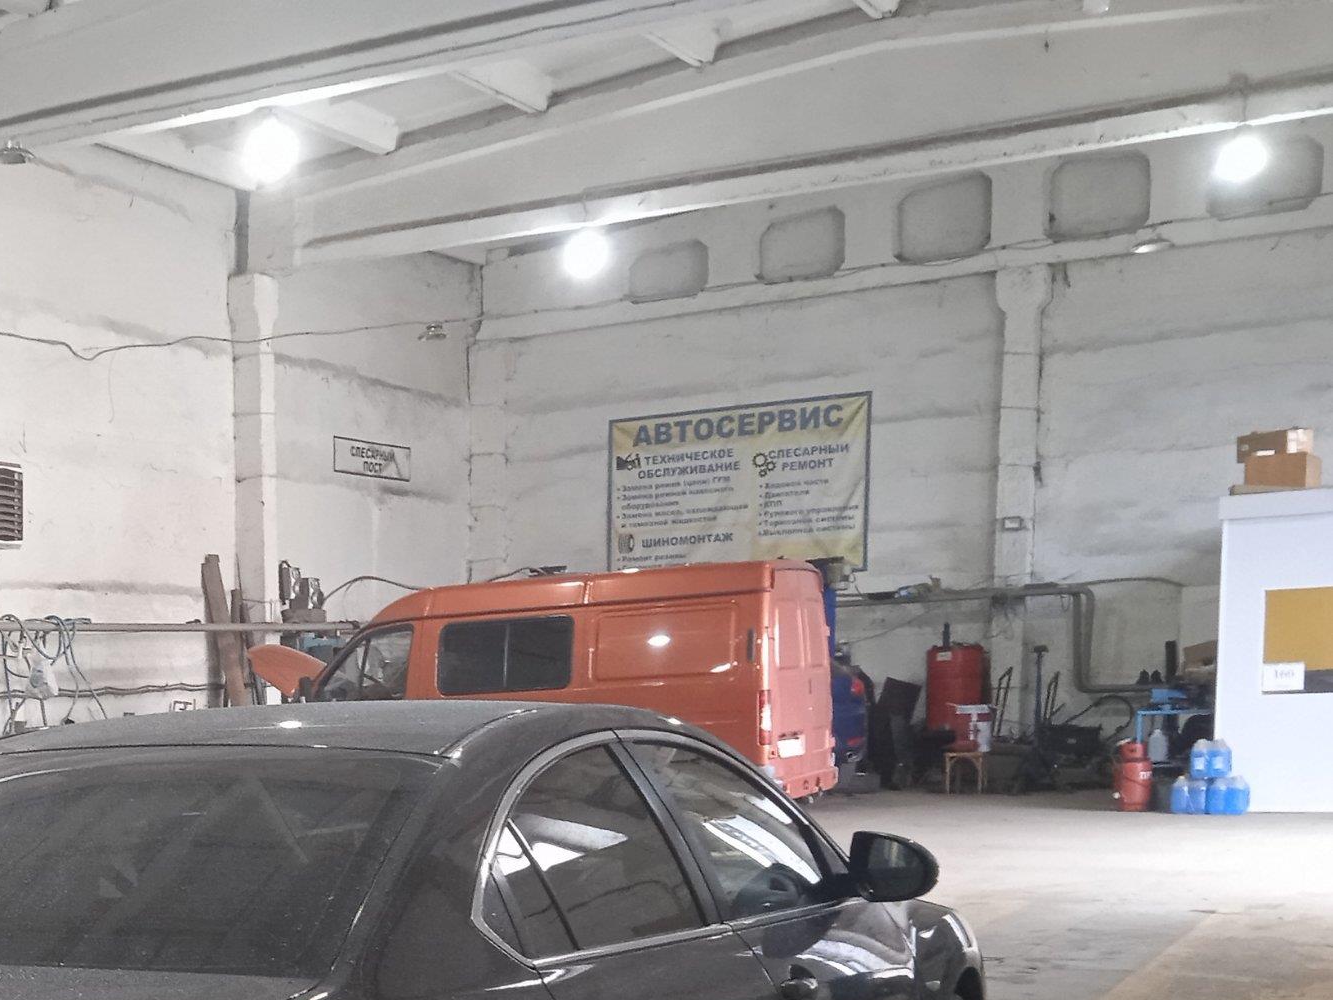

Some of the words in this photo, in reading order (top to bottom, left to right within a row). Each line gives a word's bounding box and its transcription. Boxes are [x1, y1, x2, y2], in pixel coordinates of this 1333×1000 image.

[632, 403, 843, 447] АВТОСЕРВИС
[644, 448, 734, 466] ТЕХНИЧЕСКОЕ
[781, 458, 834, 471] РЕМОНТ
[638, 461, 741, 479] ОБСЛУЖИВАНИЕ
[641, 532, 733, 549] ШИНОМОНТАЖ
